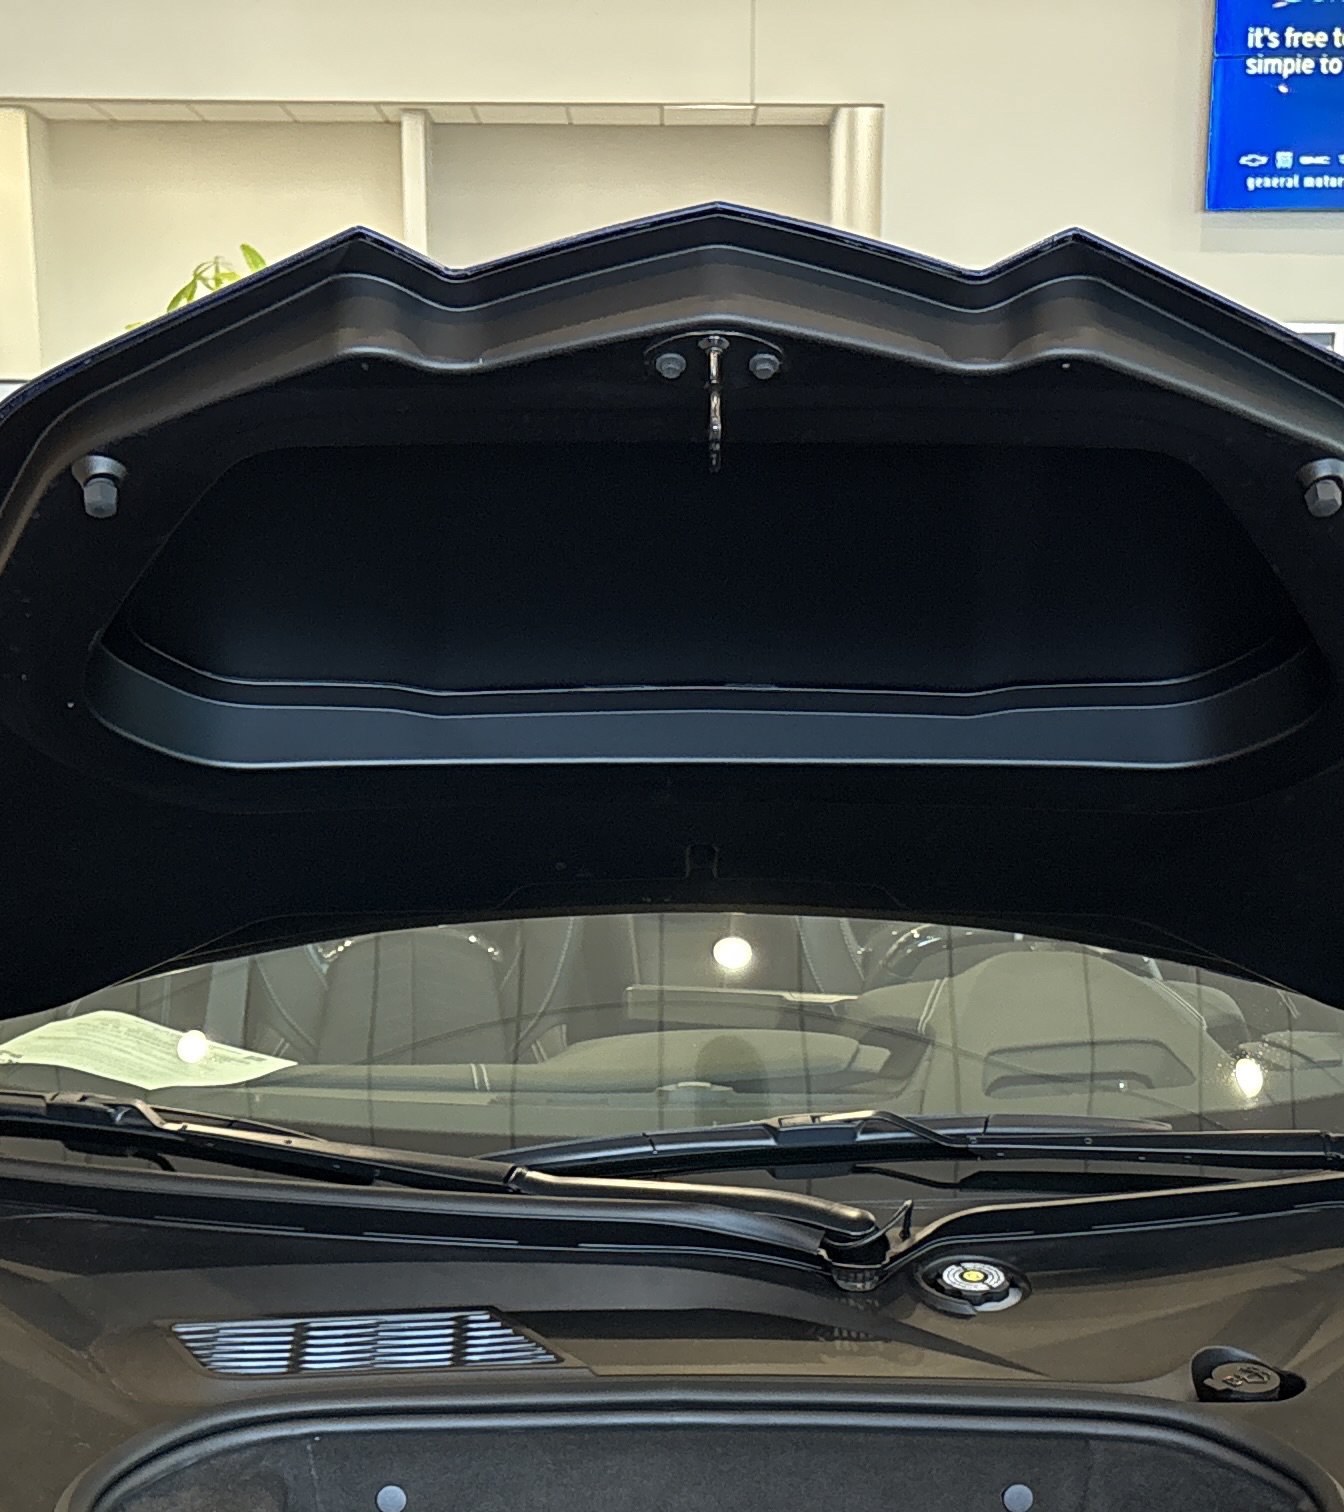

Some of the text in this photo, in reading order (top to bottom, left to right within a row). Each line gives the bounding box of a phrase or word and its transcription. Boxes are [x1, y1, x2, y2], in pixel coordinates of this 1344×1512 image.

[1247, 26, 1280, 48] it's
[1284, 26, 1329, 48] free
[1319, 54, 1343, 75] to
[1246, 174, 1299, 191] general
